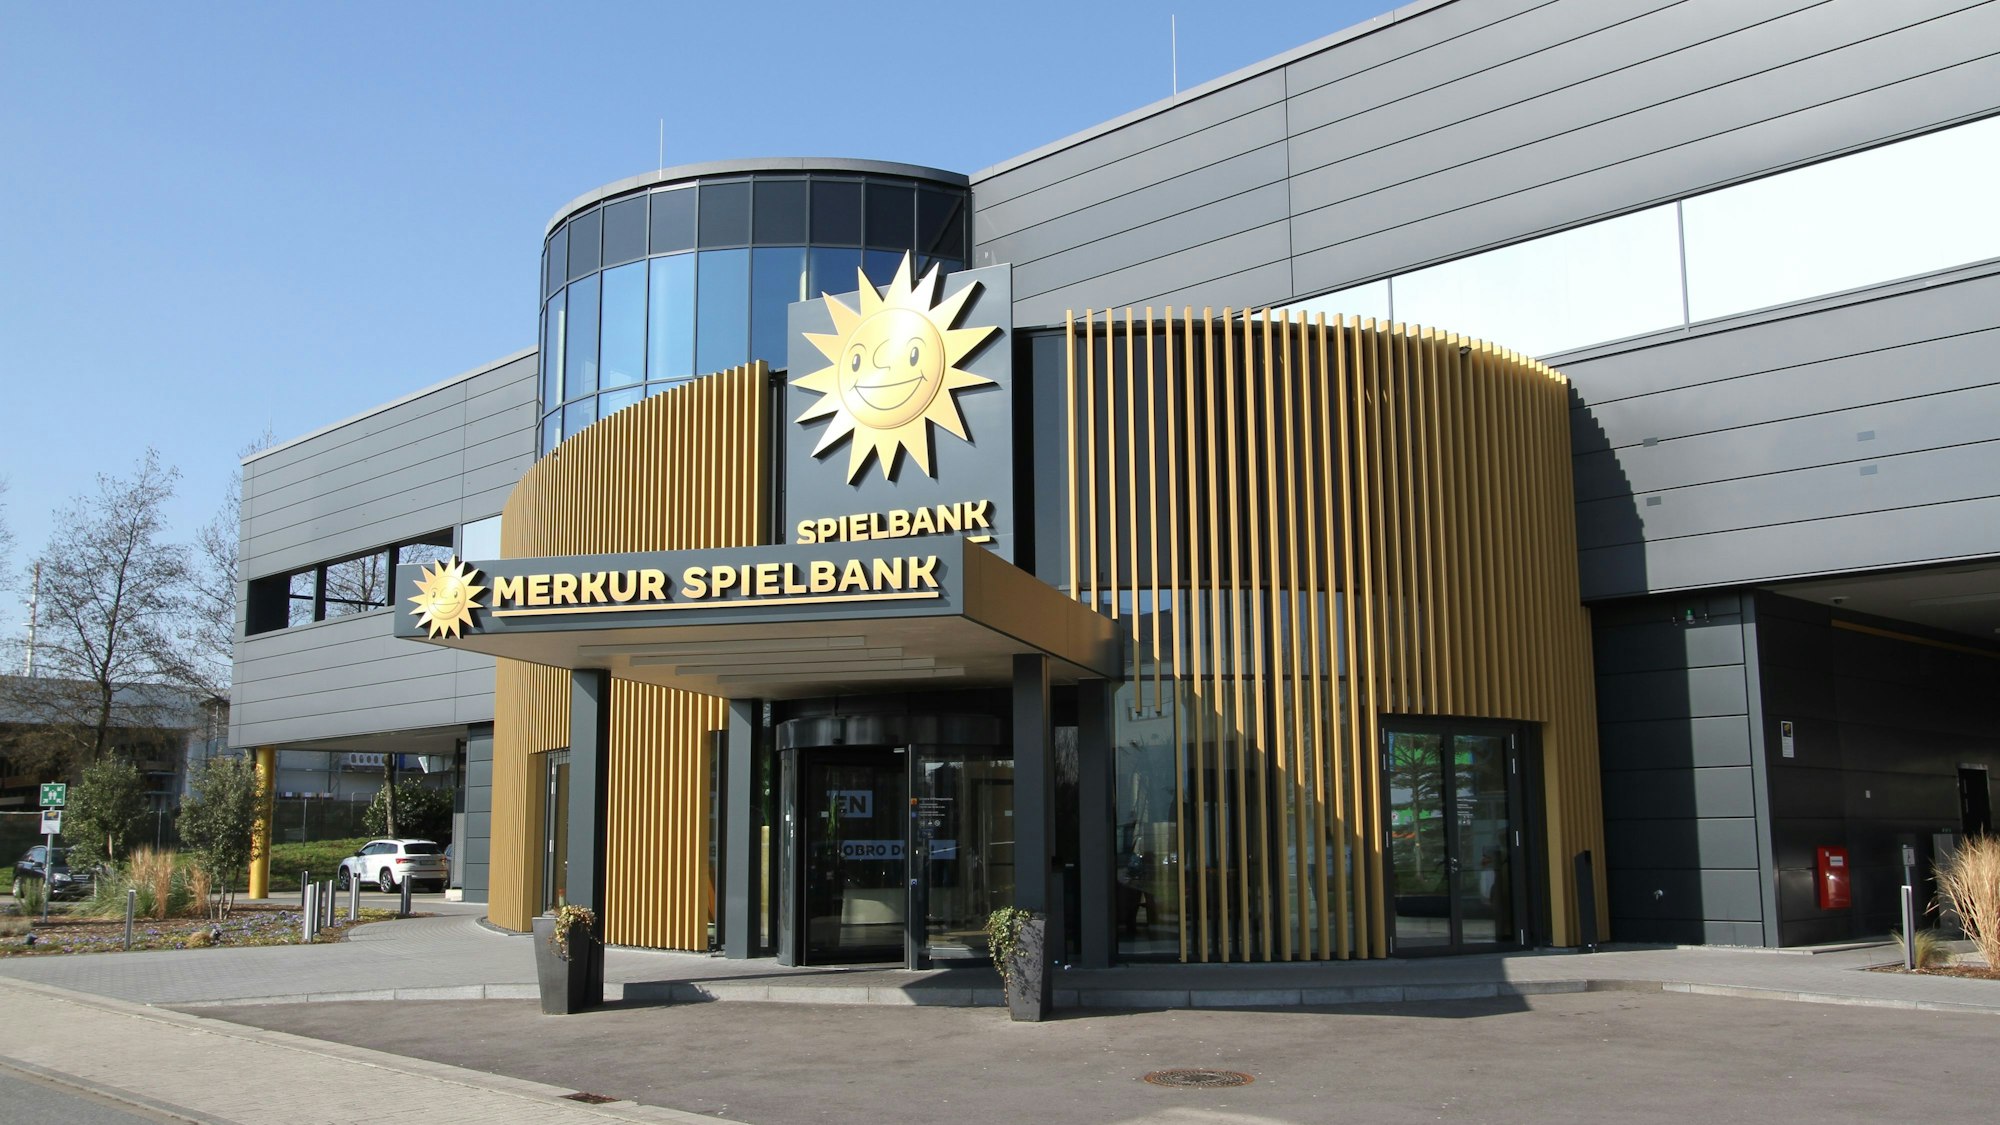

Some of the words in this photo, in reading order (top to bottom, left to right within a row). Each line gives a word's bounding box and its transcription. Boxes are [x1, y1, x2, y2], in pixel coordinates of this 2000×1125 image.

[796, 499, 990, 545] SPIELBANK
[491, 568, 667, 607] MERKUR
[681, 555, 940, 599] SPIELBANK
[836, 795, 866, 814] EN
[842, 844, 887, 857] OBRO
